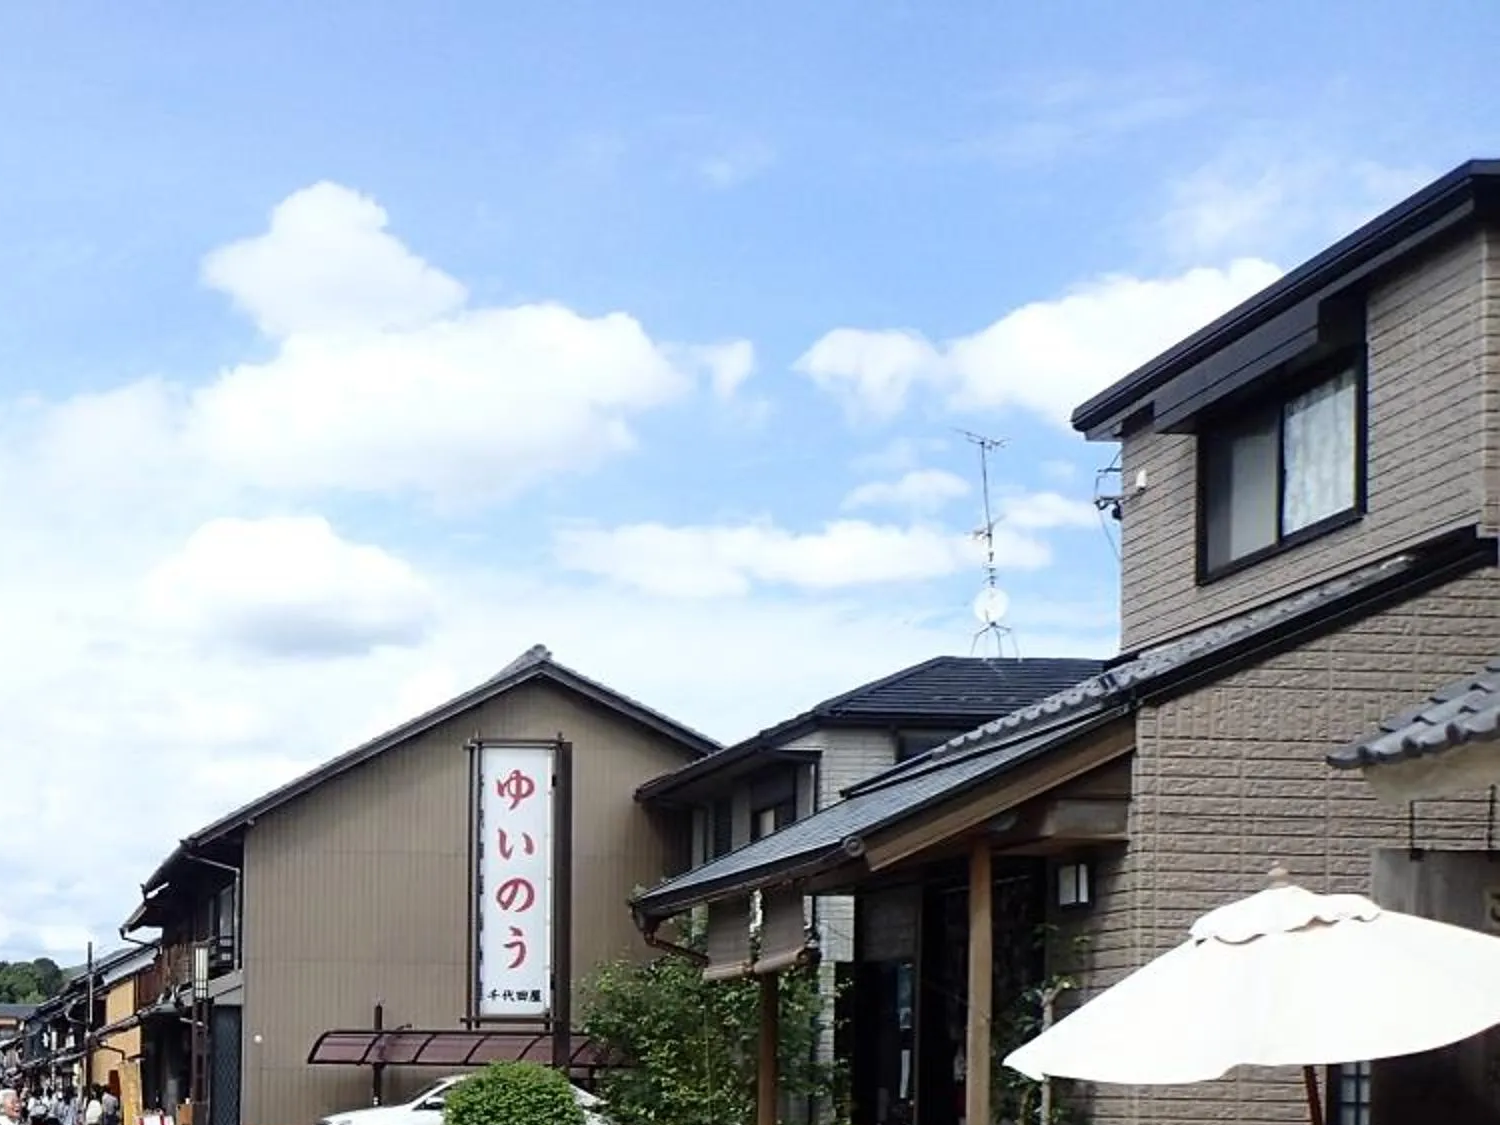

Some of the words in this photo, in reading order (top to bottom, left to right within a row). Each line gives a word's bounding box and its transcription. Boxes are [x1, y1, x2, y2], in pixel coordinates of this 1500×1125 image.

[495, 768, 536, 970] ゆいのう
[487, 988, 543, 1003] 千代田屋
